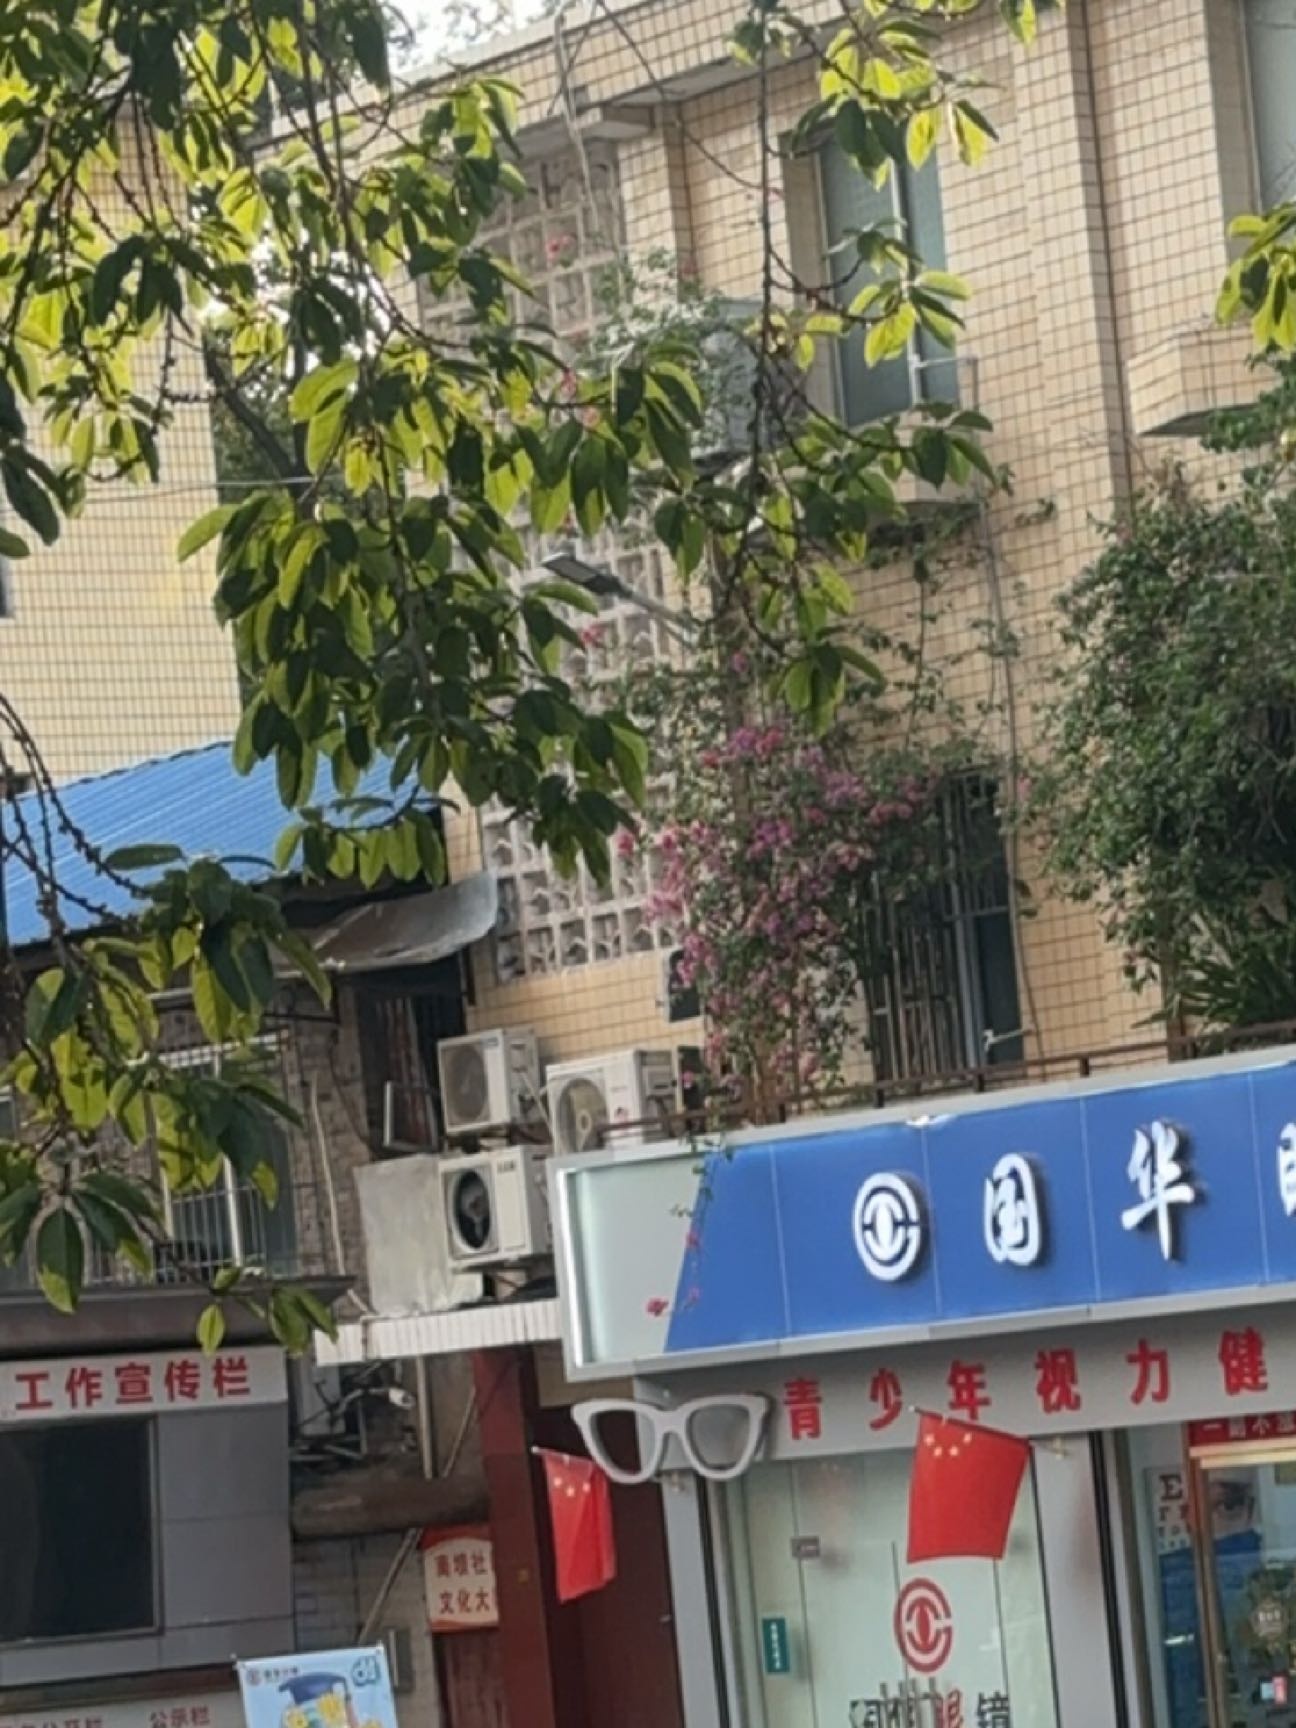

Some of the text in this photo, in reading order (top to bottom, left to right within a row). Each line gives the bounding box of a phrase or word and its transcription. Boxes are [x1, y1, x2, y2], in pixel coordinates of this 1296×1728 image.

[14, 1356, 253, 1411] 工作宣传栏
